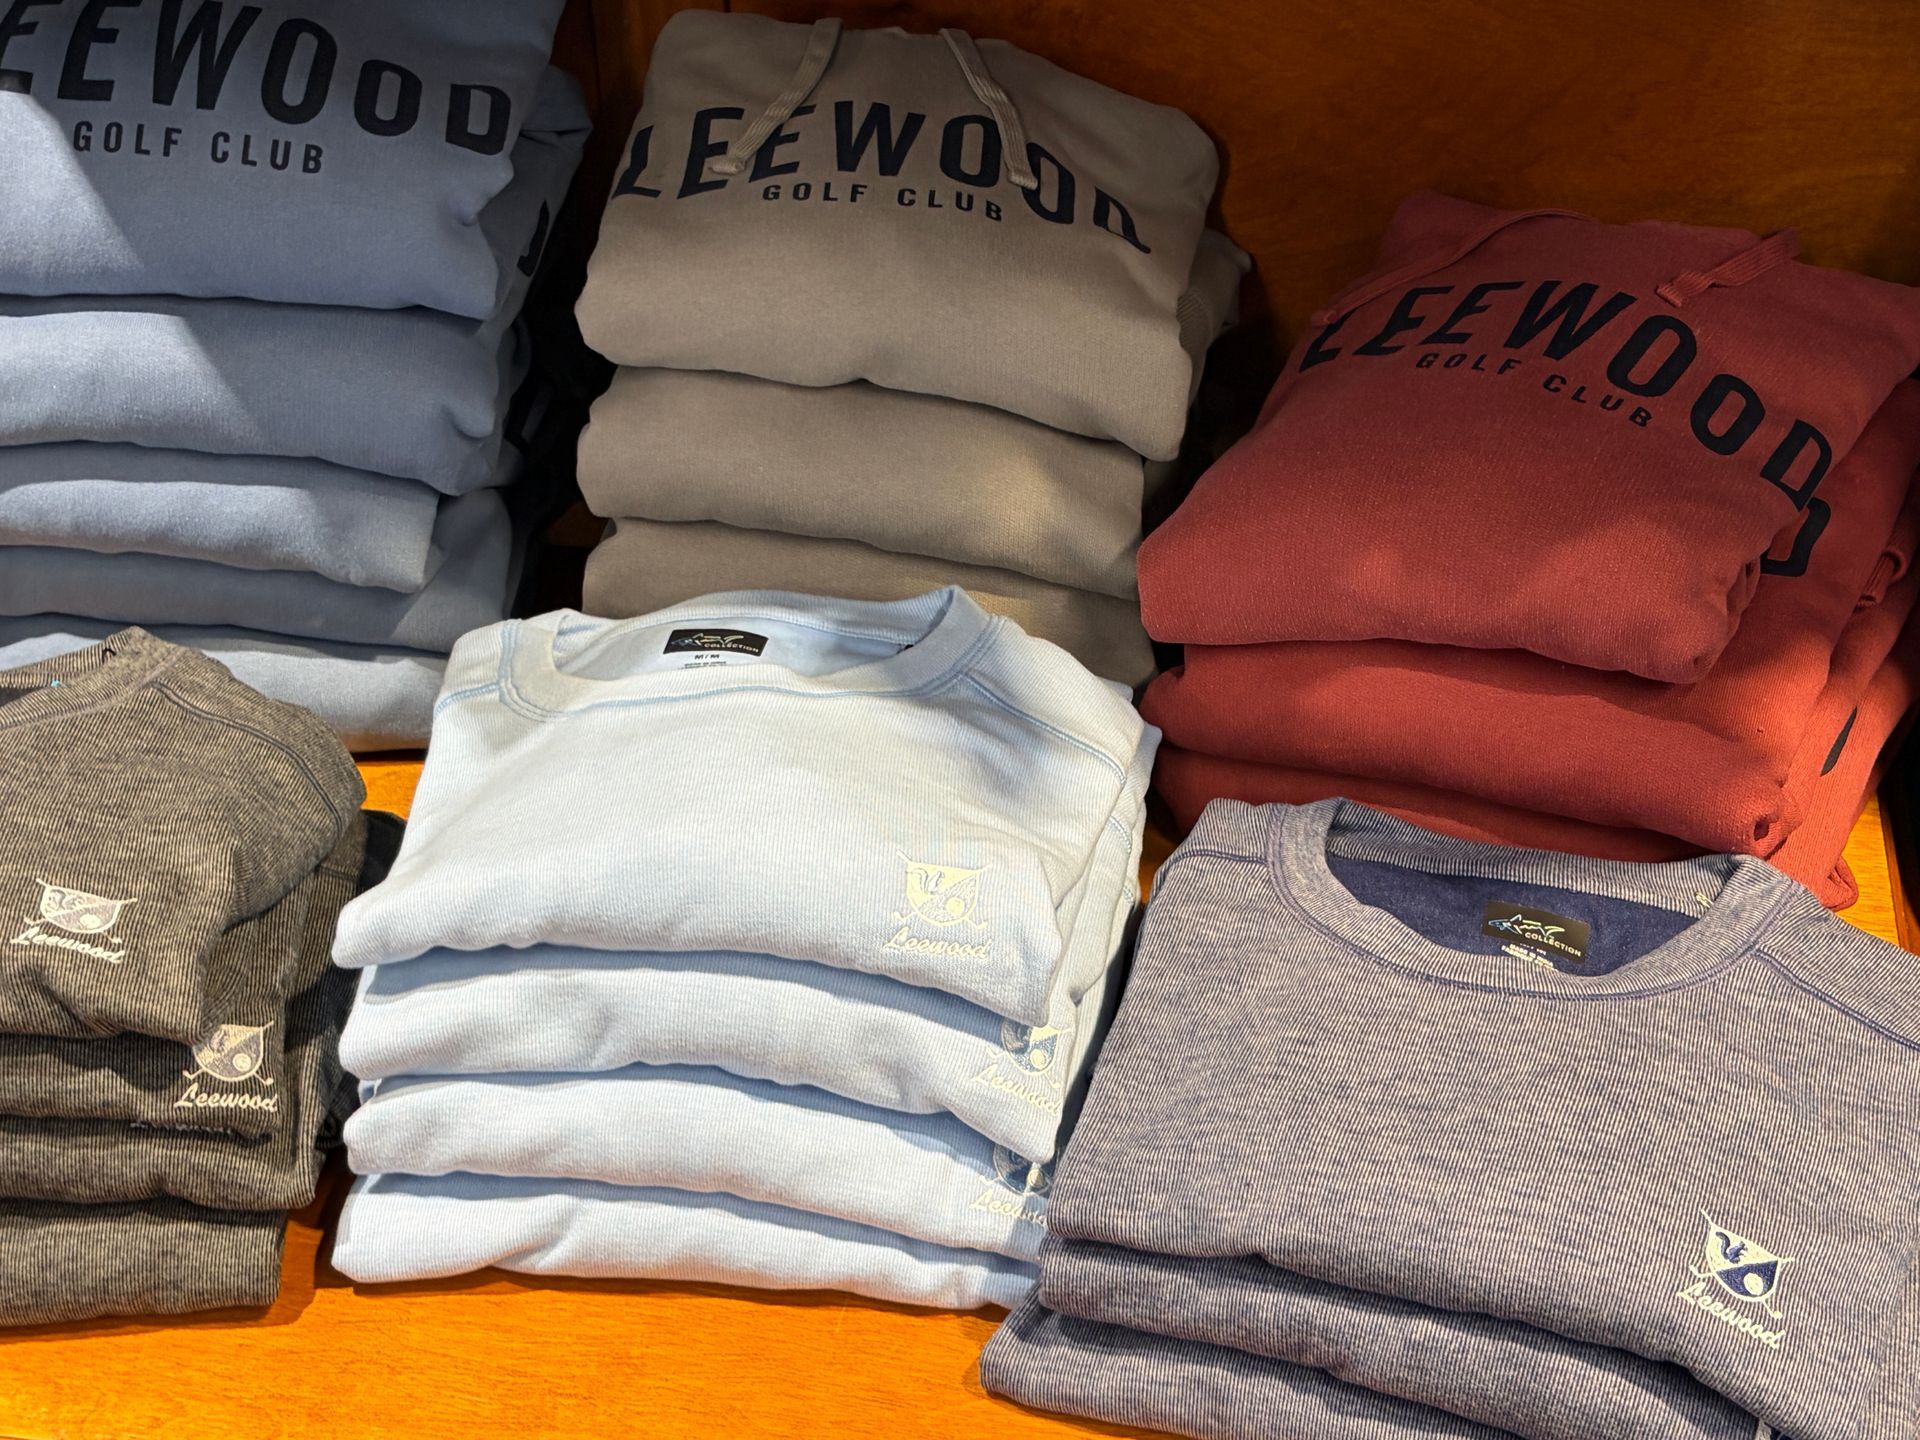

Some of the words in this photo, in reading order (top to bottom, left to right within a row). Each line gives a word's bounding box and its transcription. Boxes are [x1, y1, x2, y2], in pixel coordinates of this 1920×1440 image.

[73, 120, 182, 157] GOLF
[210, 132, 325, 174] CLUB
[762, 183, 868, 202] GOLF
[897, 188, 1003, 222] CLUB
[1299, 280, 1833, 513] LEEWOOD
[1415, 352, 1522, 376] GOLF
[1543, 374, 1652, 428] CLUB
[10, 926, 125, 964] Leewood
[882, 926, 992, 959] Leewood
[1525, 932, 1582, 957] COLLECTION
[174, 1083, 278, 1113] Leewood
[971, 1063, 1064, 1117] Leewood
[1676, 1281, 1786, 1349] Leewood
